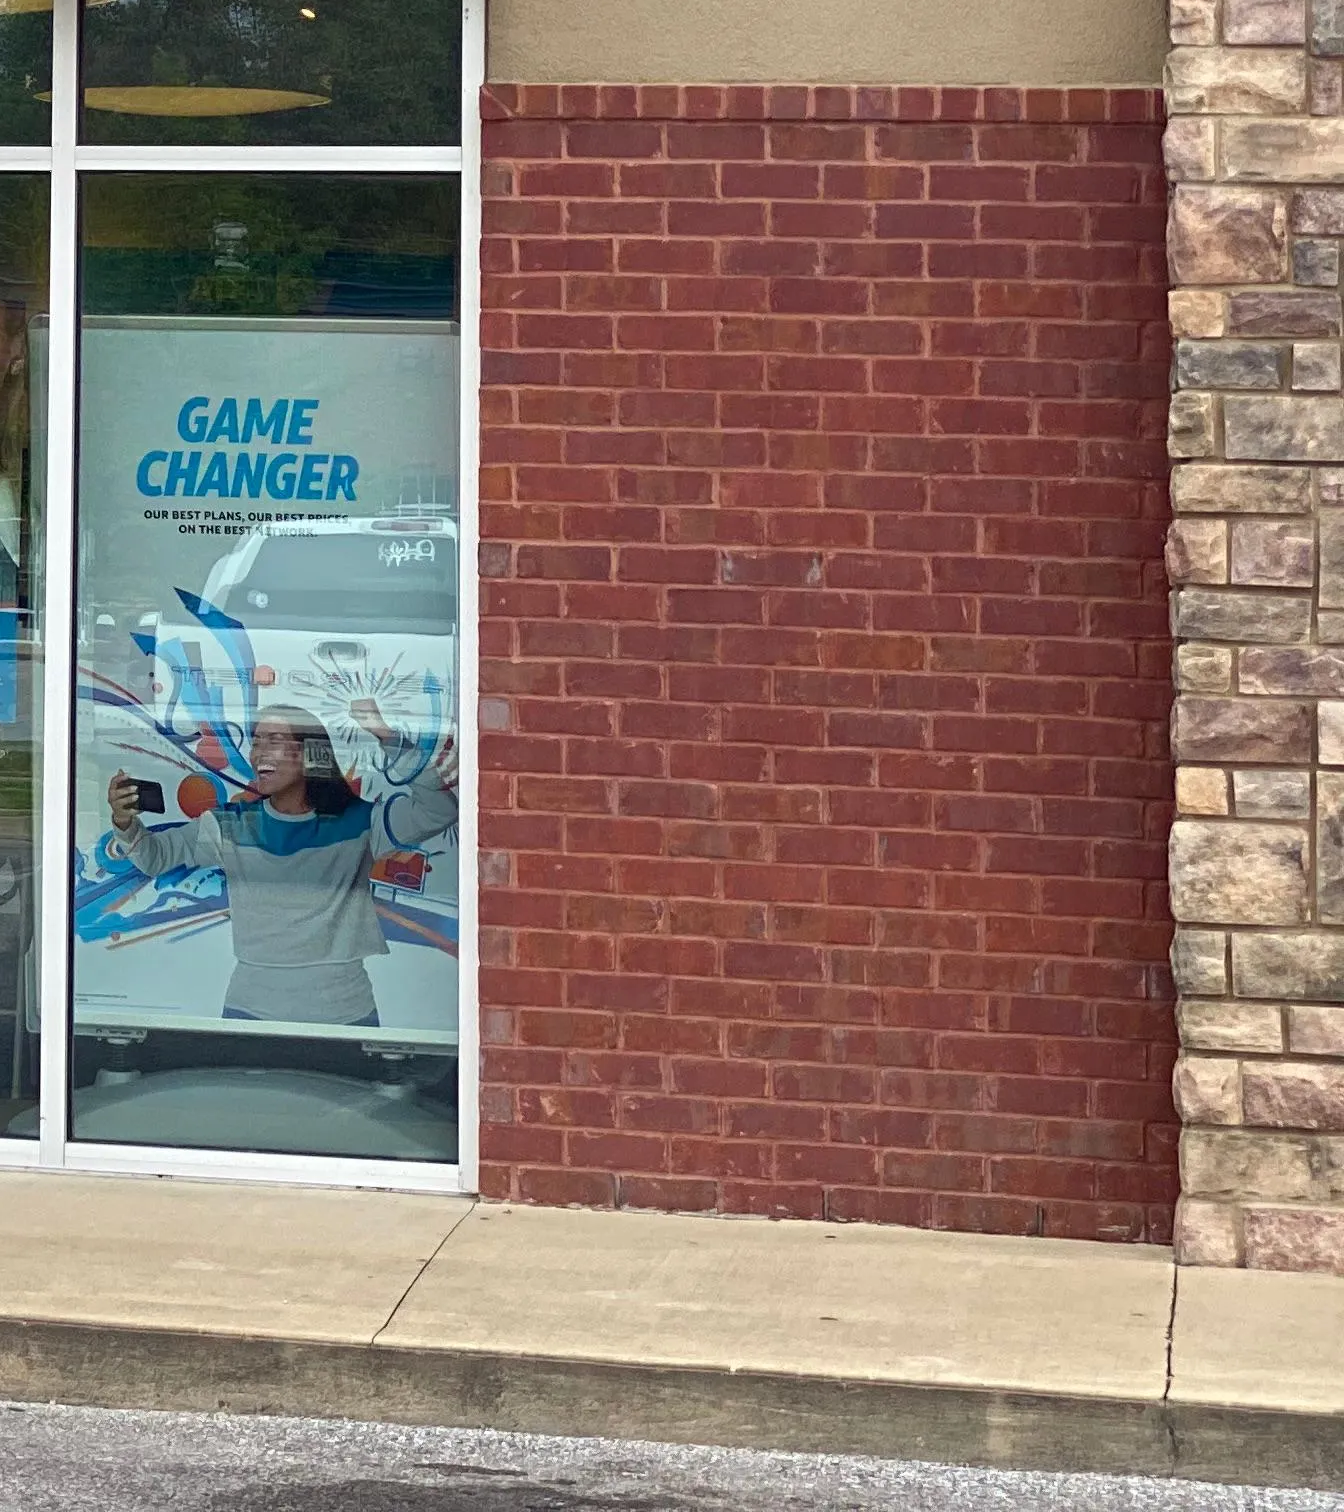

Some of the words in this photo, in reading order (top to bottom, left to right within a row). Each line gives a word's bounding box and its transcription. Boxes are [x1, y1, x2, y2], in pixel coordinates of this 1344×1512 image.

[177, 396, 319, 445] GAME
[136, 450, 360, 501] CHANGER
[143, 510, 169, 520] OUR
[172, 510, 202, 520] BEST
[204, 511, 245, 523] PLANS,
[247, 512, 272, 522] OUR
[275, 513, 305, 523] BEST
[178, 524, 196, 534] ON
[198, 525, 221, 534] THE
[223, 525, 251, 535] BEST
